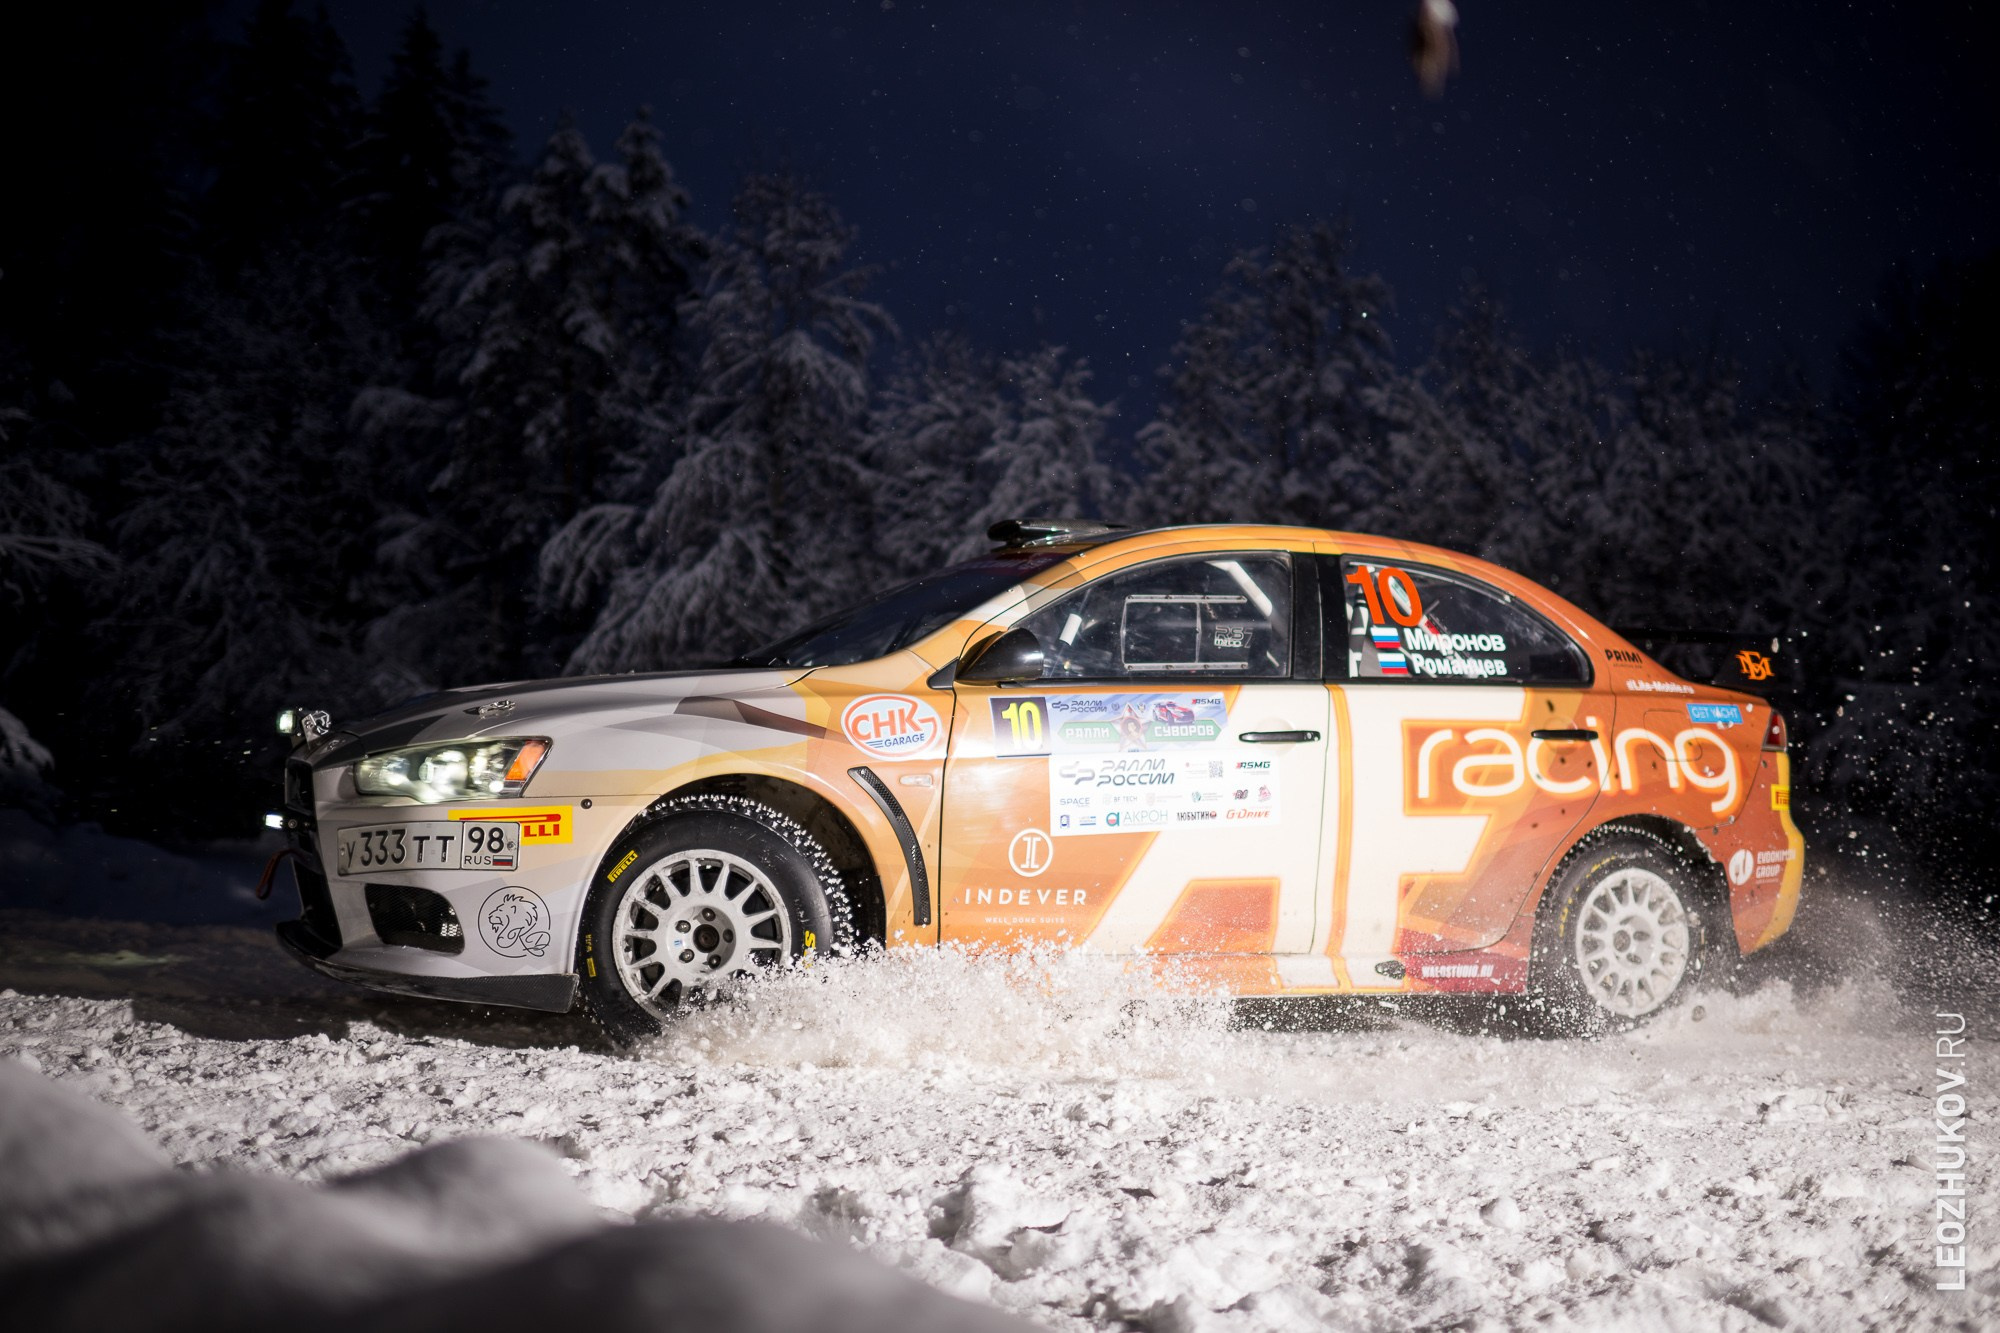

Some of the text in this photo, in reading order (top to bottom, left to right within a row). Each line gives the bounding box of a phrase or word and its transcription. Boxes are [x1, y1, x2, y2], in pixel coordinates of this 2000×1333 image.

[1346, 565, 1423, 627] 10
[1403, 628, 1506, 656] Миронов
[1604, 648, 1643, 664] PRIMI
[1412, 653, 1507, 678] Романцев
[1691, 706, 1709, 719] GET
[851, 704, 922, 741] CHK
[1001, 701, 1044, 751] 10
[1065, 726, 1110, 739] РАЛЛИ
[1153, 724, 1215, 738] СУВОРОВ
[884, 733, 925, 748] GARAGE
[1100, 758, 1166, 772] РАЛЛИ
[1417, 716, 1738, 813] racing
[1096, 772, 1175, 787] РОССИИ
[1059, 797, 1091, 805] SPACE
[1123, 810, 1168, 823] АКРОН
[467, 826, 505, 854] 98
[464, 856, 491, 865] RUS
[607, 849, 639, 883] PIRELLI
[1756, 864, 1781, 879] GROUP
[964, 888, 1087, 905] INDEVER
